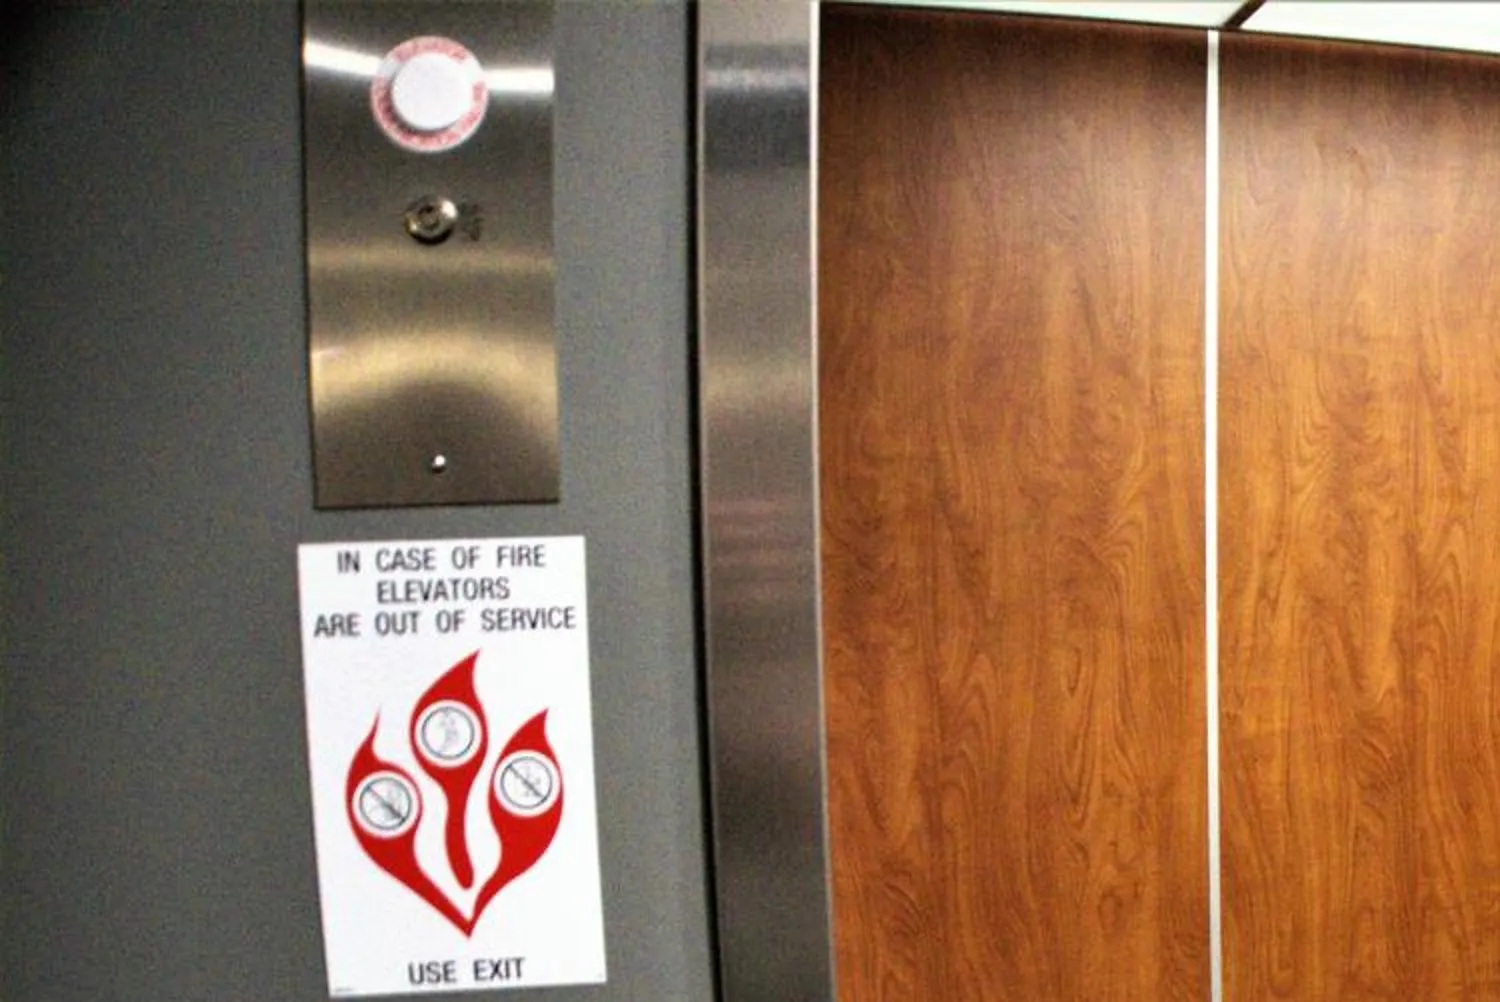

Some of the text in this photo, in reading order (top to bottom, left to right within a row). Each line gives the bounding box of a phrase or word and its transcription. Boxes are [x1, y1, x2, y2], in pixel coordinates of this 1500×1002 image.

[337, 544, 546, 573] IN CASE OF FIRE
[376, 576, 511, 604] ELEVATORS
[313, 606, 576, 637] ARE OUT OF SERVICE
[408, 957, 525, 985] USE EXIT
